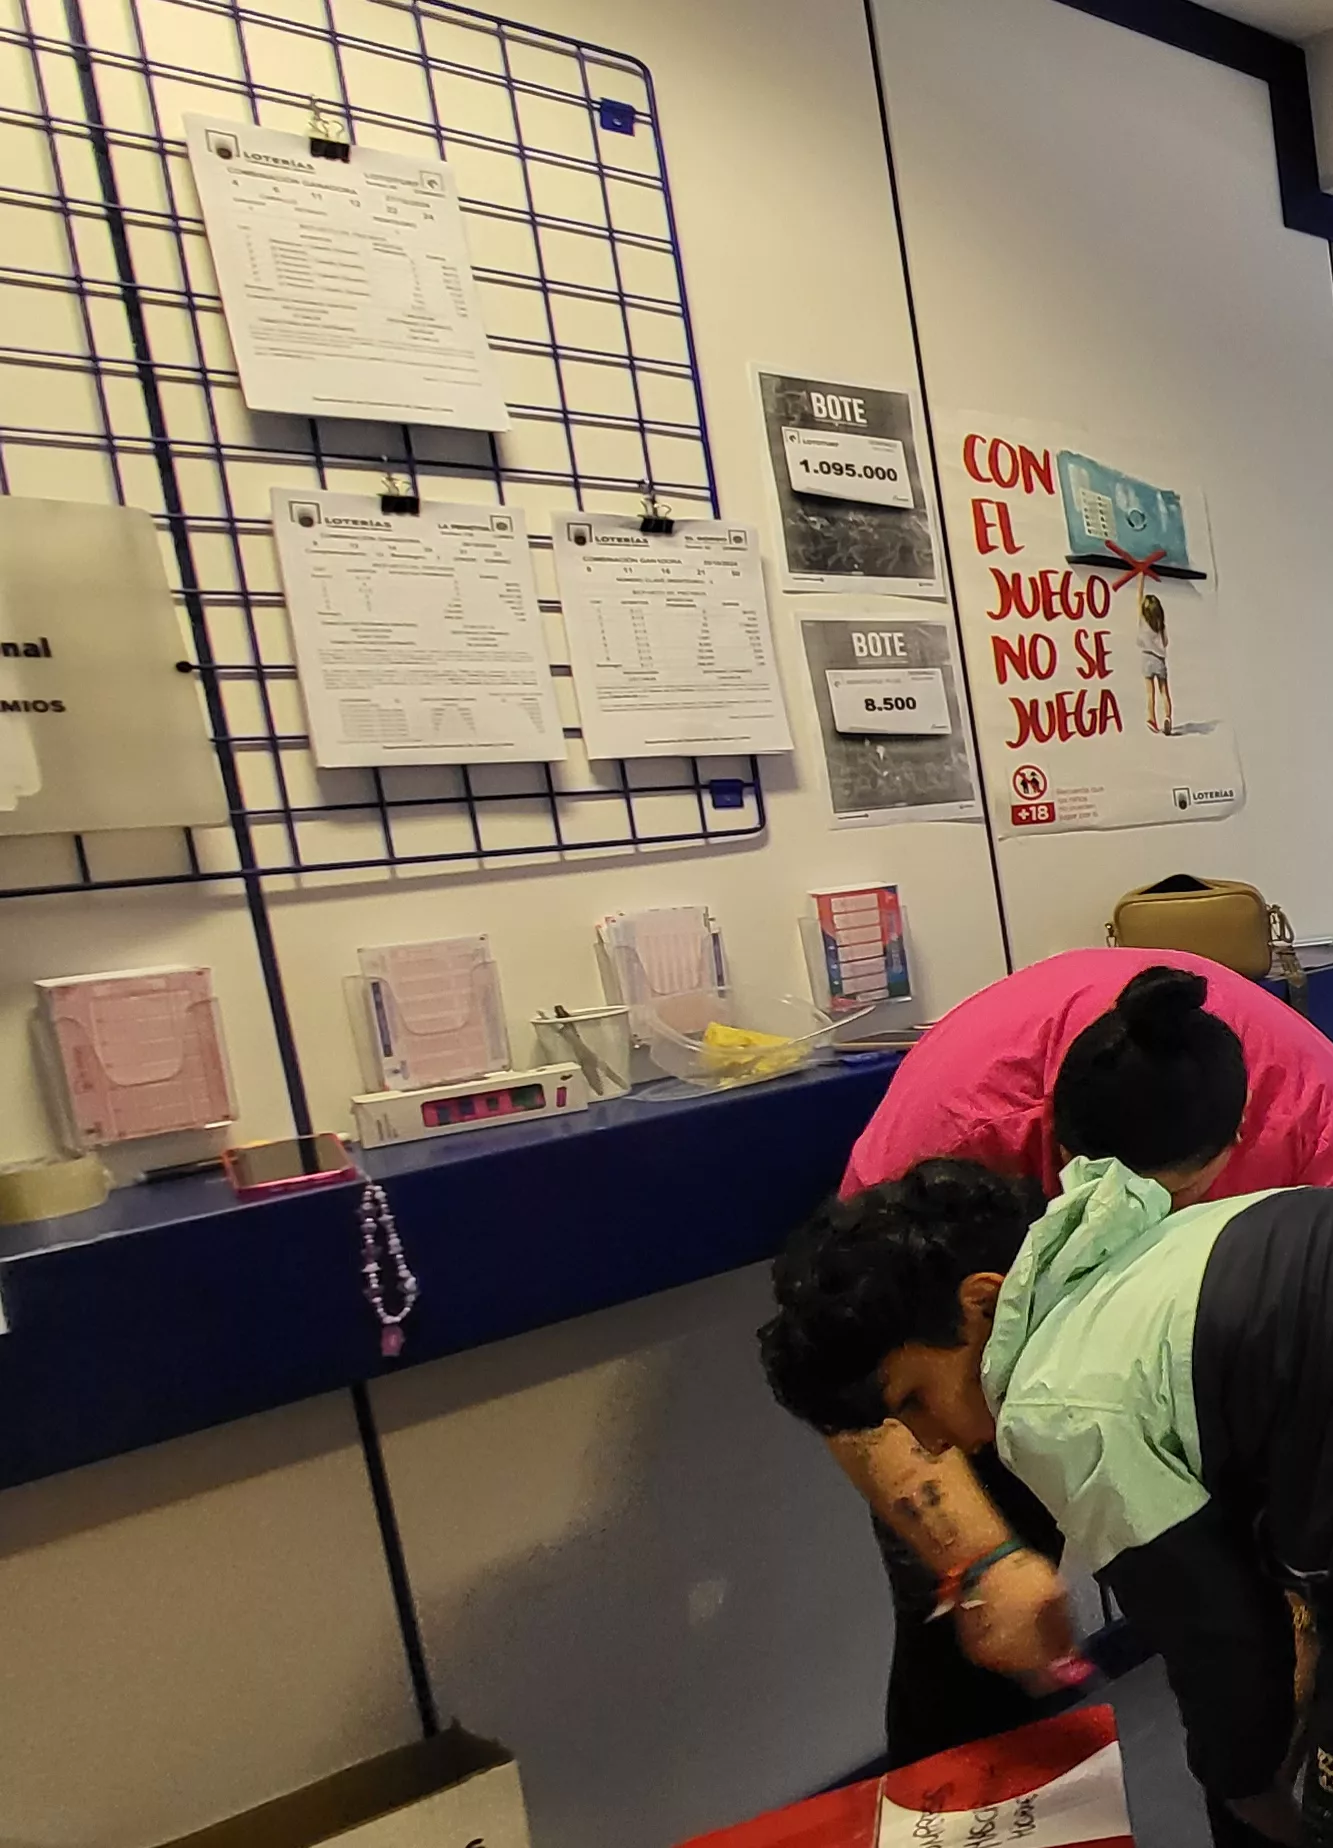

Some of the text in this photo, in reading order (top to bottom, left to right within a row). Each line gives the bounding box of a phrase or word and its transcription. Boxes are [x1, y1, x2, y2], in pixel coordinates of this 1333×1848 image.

[810, 392, 868, 425] BOTE
[799, 459, 898, 482] 1.095.000
[963, 433, 1056, 495] CON
[971, 498, 1025, 554] EL
[595, 536, 649, 544] LOTERÍAS
[986, 567, 1111, 621] JUEGO
[0, 636, 52, 658] nal
[852, 632, 908, 658] BOTE
[991, 629, 1113, 685] NO SE
[0, 699, 66, 713] MIOS
[864, 696, 917, 712] 8.500
[1005, 688, 1123, 749] JUEGA
[1192, 789, 1234, 801] LOTERÍAS
[1017, 805, 1050, 822] +18
